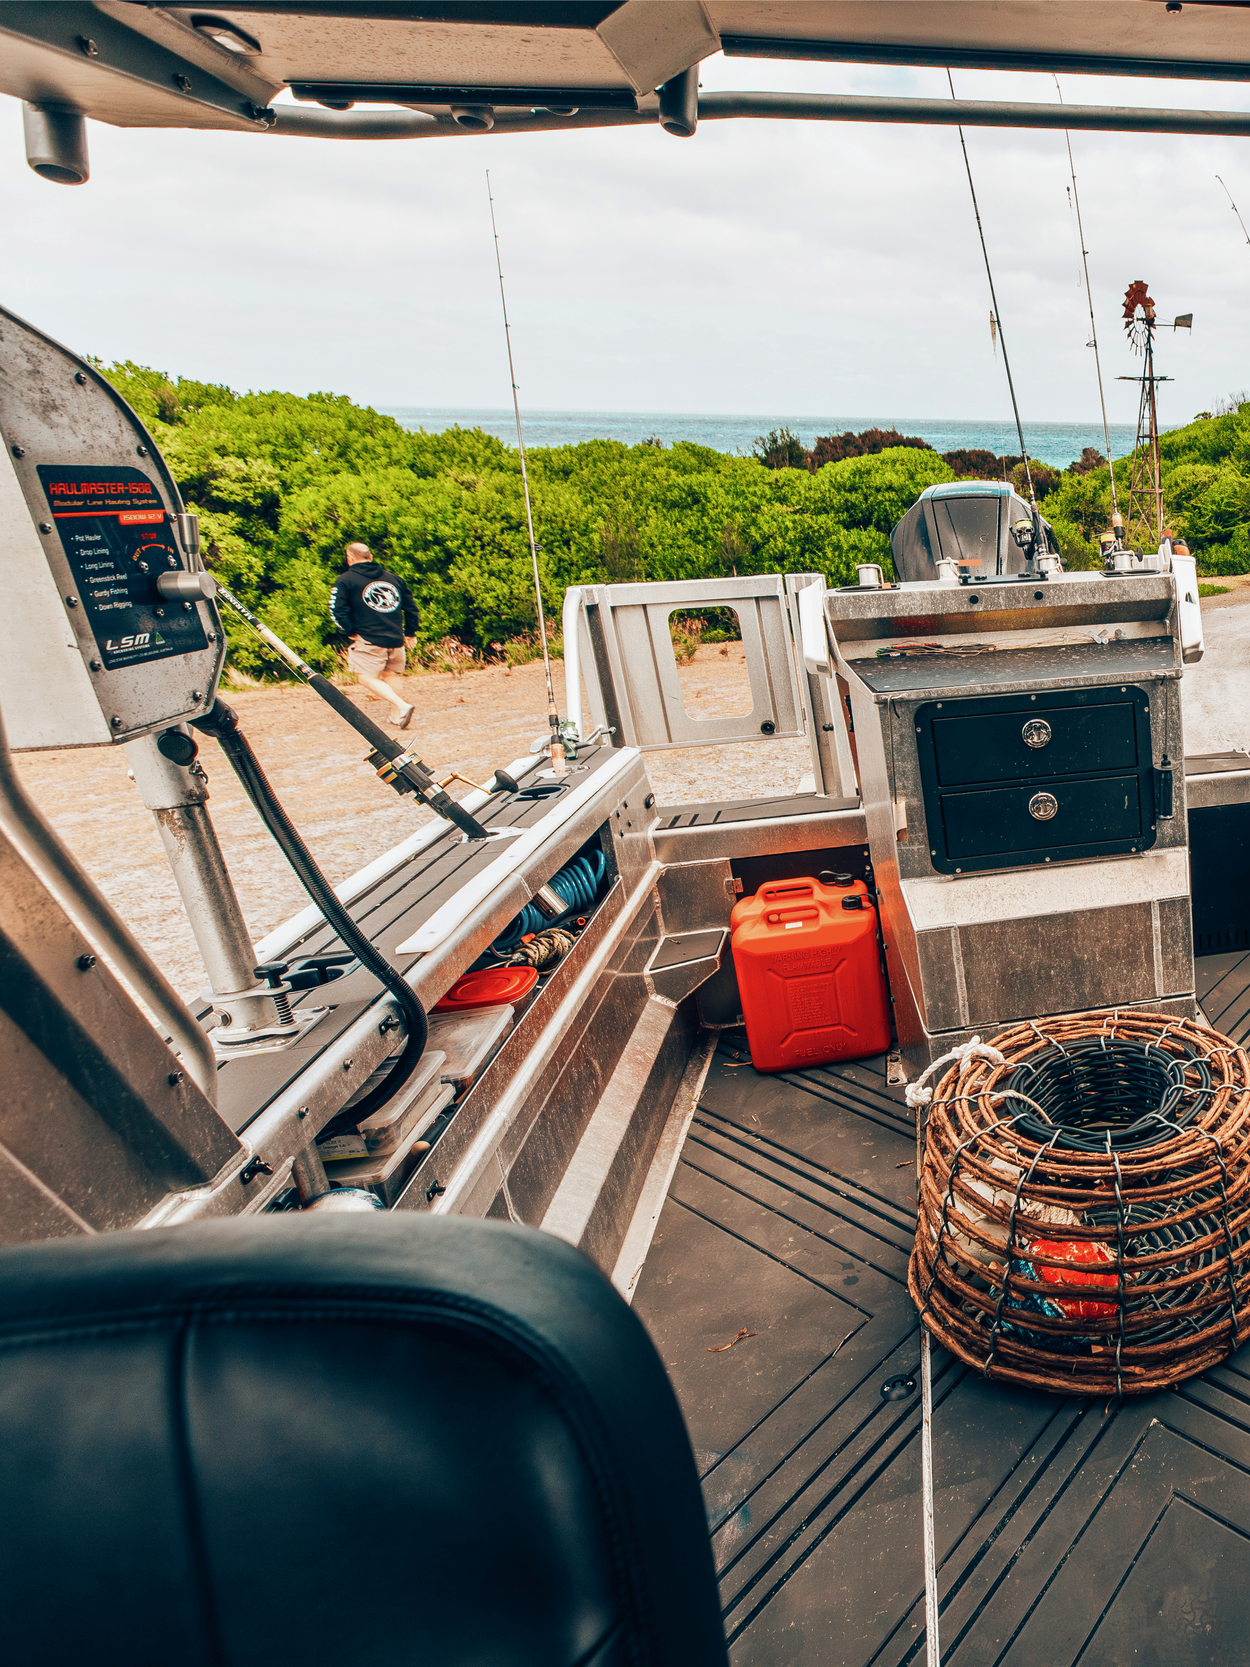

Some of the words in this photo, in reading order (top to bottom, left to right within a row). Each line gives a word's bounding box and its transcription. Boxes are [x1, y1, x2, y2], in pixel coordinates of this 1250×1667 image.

[132, 547, 142, 561] OUT
[217, 586, 256, 621] MARINER
[106, 633, 150, 650] LSM
[769, 952, 809, 962] WARNING
[812, 947, 841, 958] HIGHLY
[795, 1047, 820, 1057] FUEL
[823, 1042, 846, 1054] ONLY
